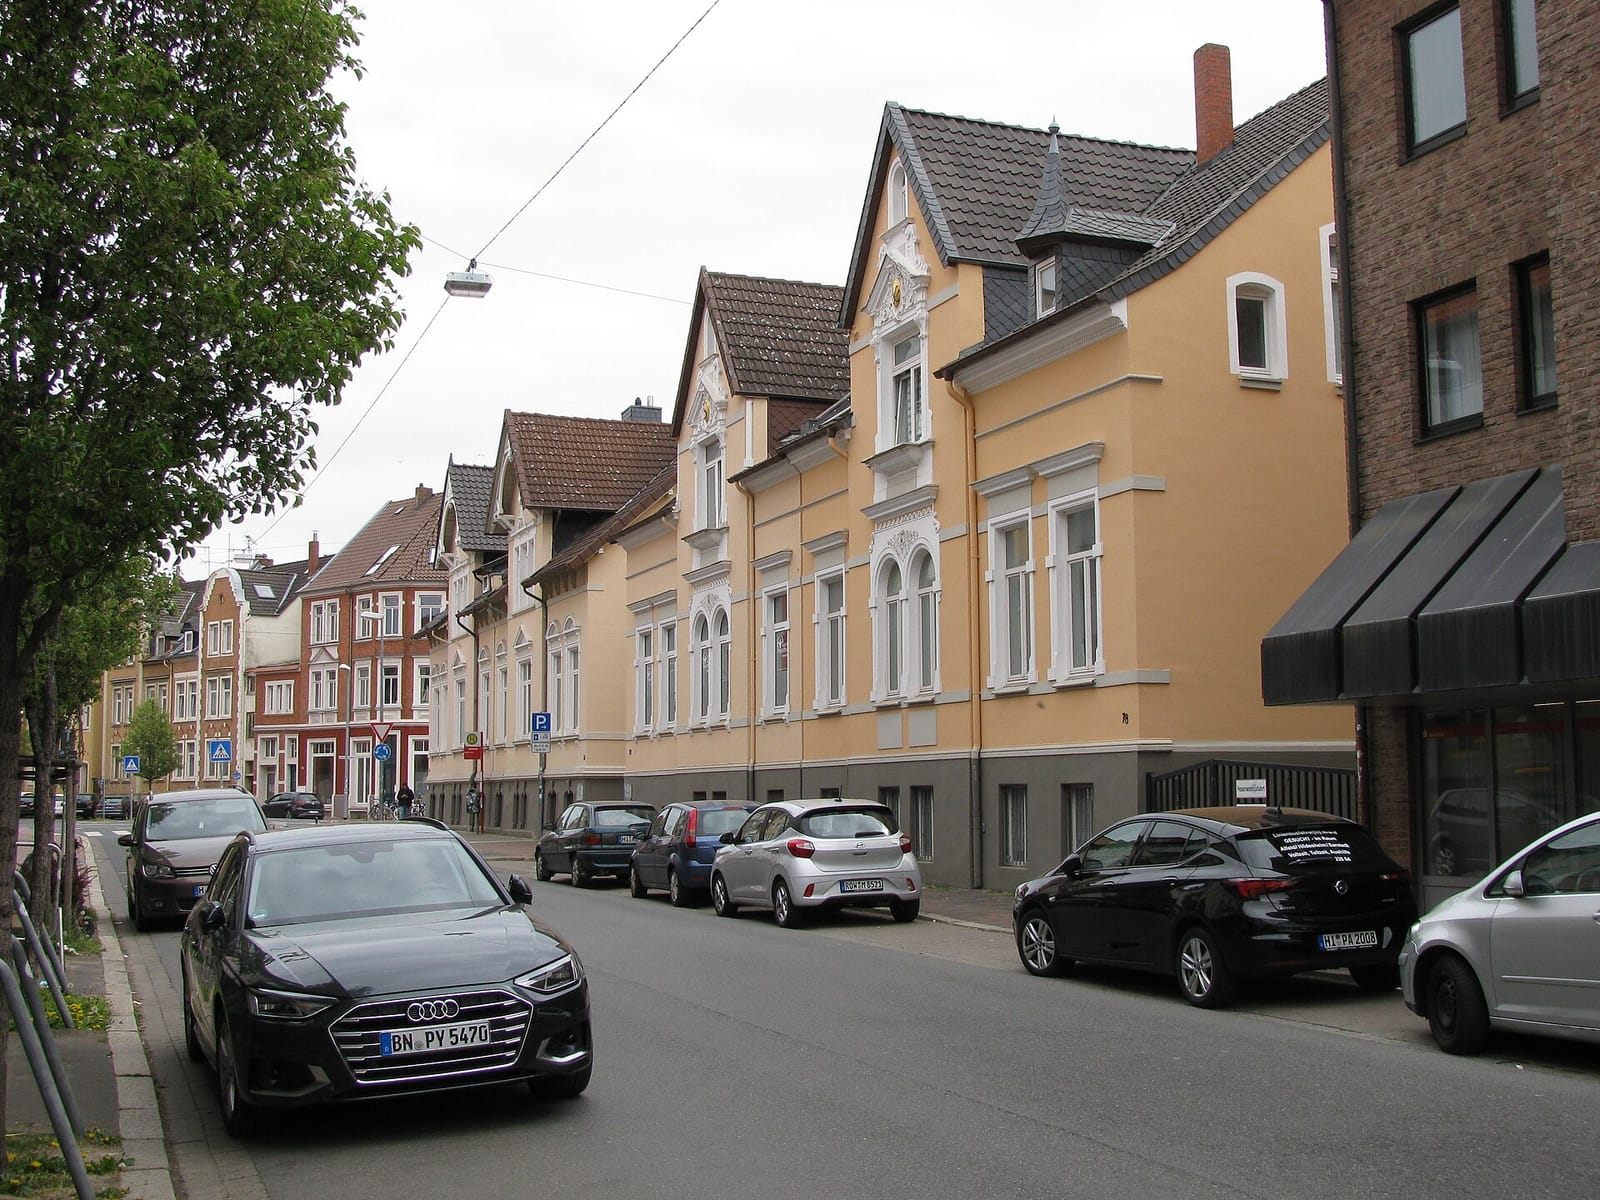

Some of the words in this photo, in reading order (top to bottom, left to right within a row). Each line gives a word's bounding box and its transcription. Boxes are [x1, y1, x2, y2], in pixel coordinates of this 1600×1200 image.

[536, 715, 546, 730] P
[1323, 935, 1336, 947] HI
[1341, 933, 1353, 946] PA
[1354, 931, 1376, 945] 2008
[392, 1034, 413, 1052] BN
[425, 1030, 446, 1049] PY
[449, 1025, 488, 1046] 5470
